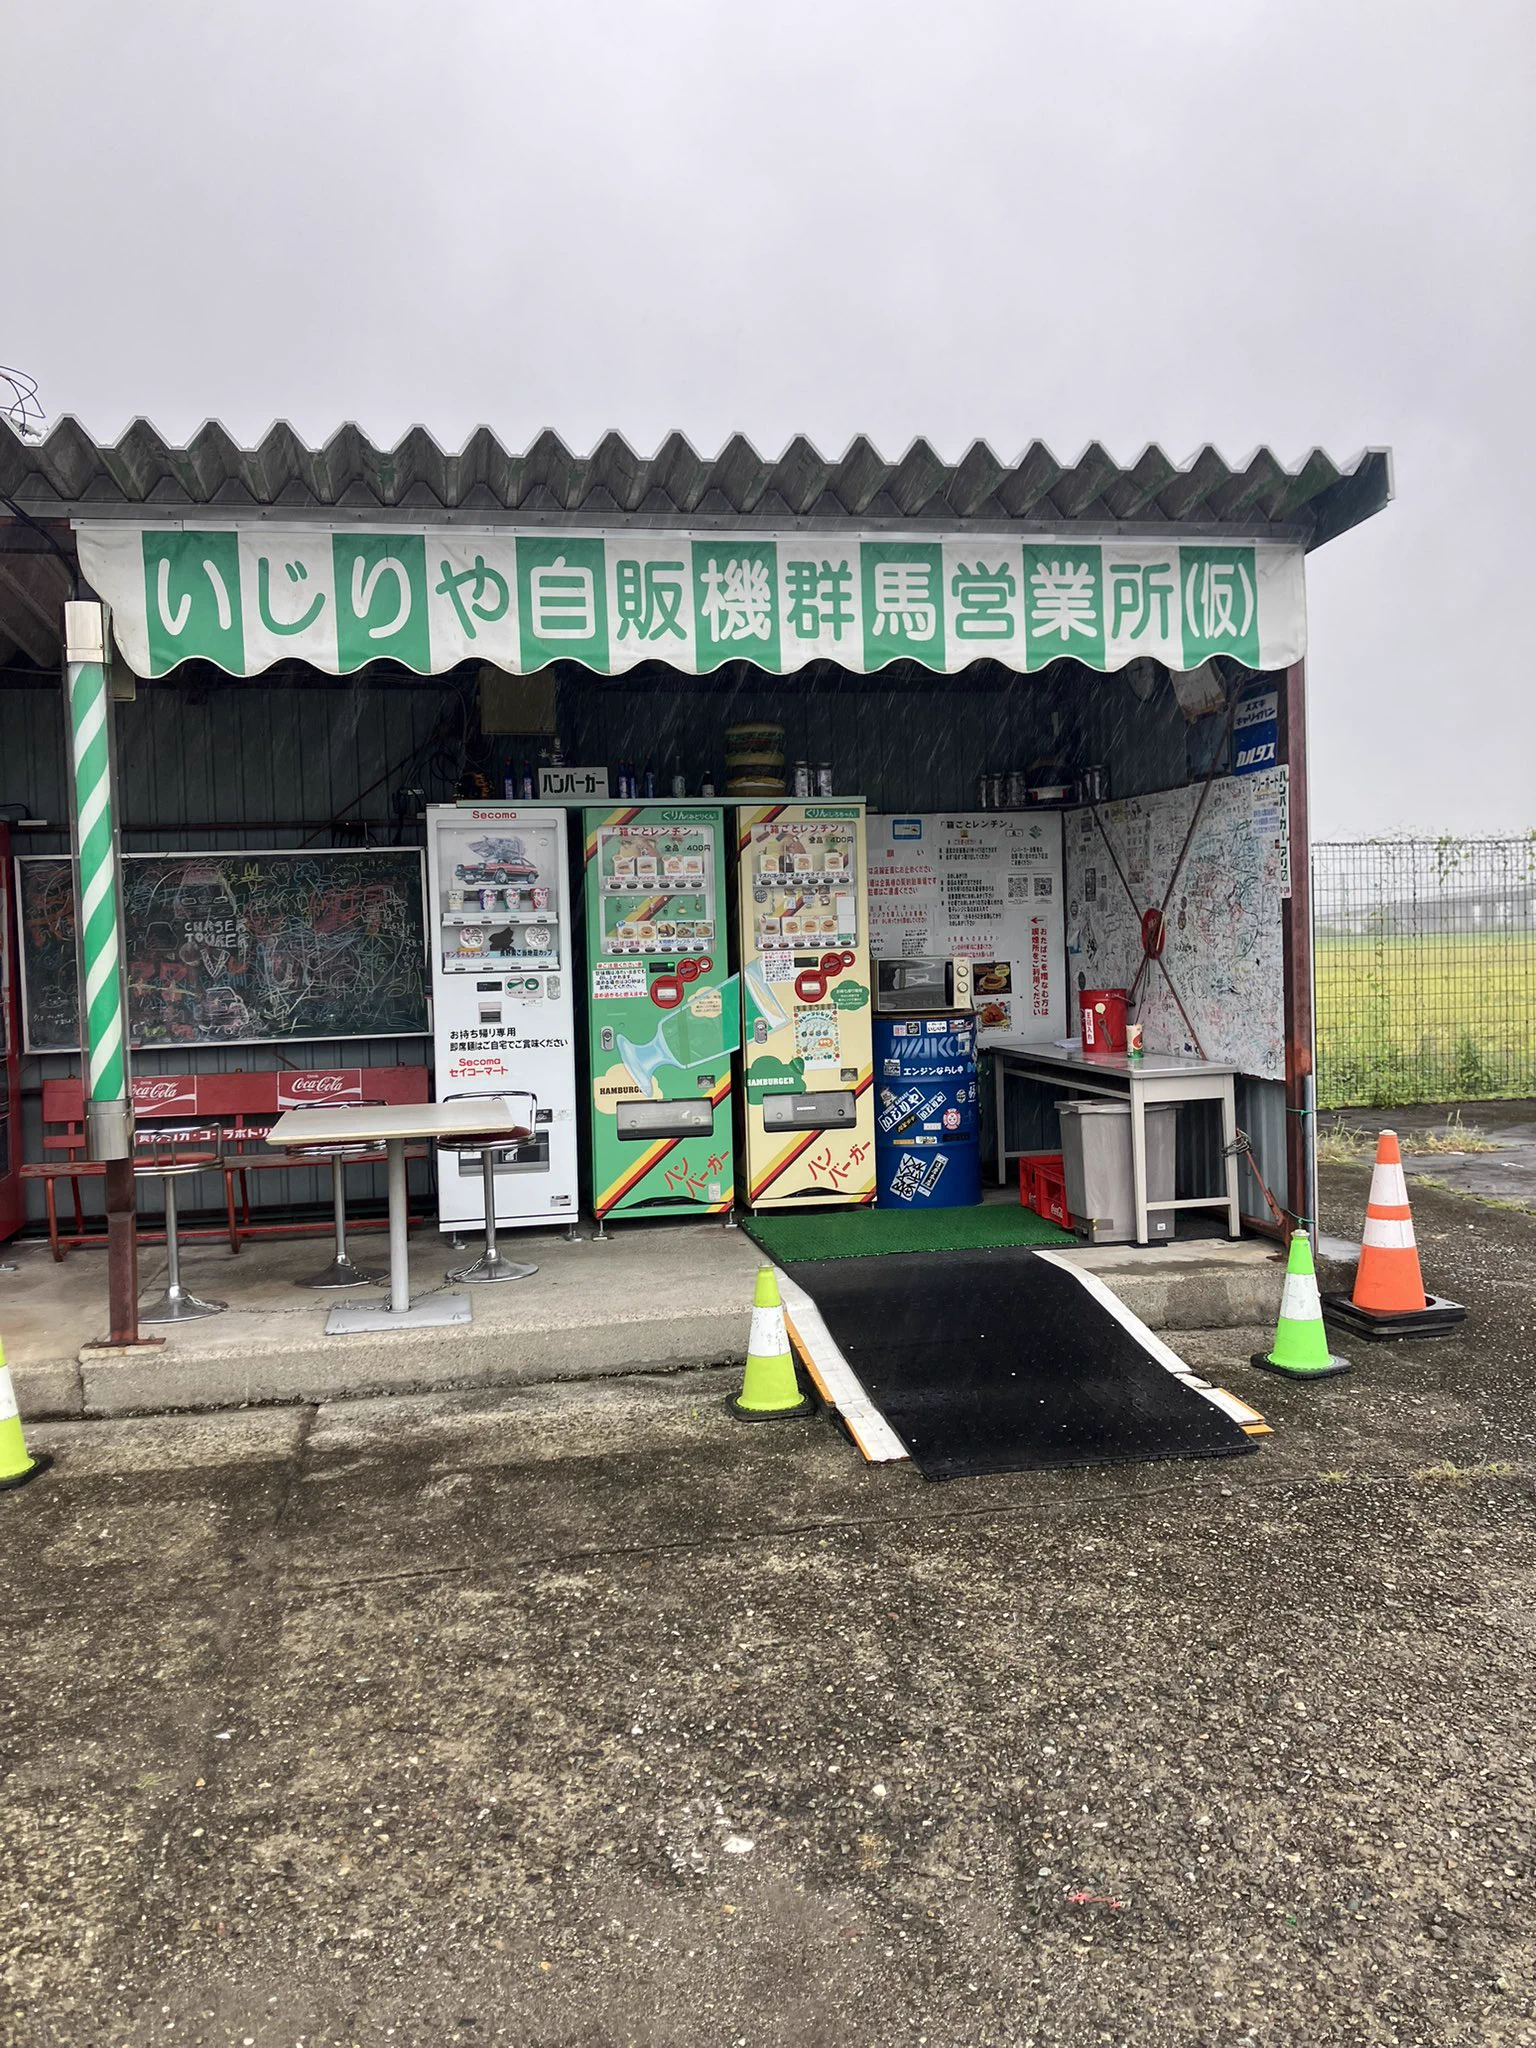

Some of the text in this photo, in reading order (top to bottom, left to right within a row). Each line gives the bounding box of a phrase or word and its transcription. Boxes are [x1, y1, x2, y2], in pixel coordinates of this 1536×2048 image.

[157, 554, 1255, 641] いじりや自販機群馬営業所(仮)
[543, 772, 605, 794] ハンバーガー
[472, 809, 517, 819] Secoma
[686, 844, 711, 852] 400円
[450, 1027, 516, 1040] お持ち帰り専用
[459, 1057, 501, 1067] Secoma
[449, 1066, 509, 1078] セイコーマート
[132, 1081, 179, 1100] oca-Cola
[291, 1076, 344, 1093] Coca-Cola
